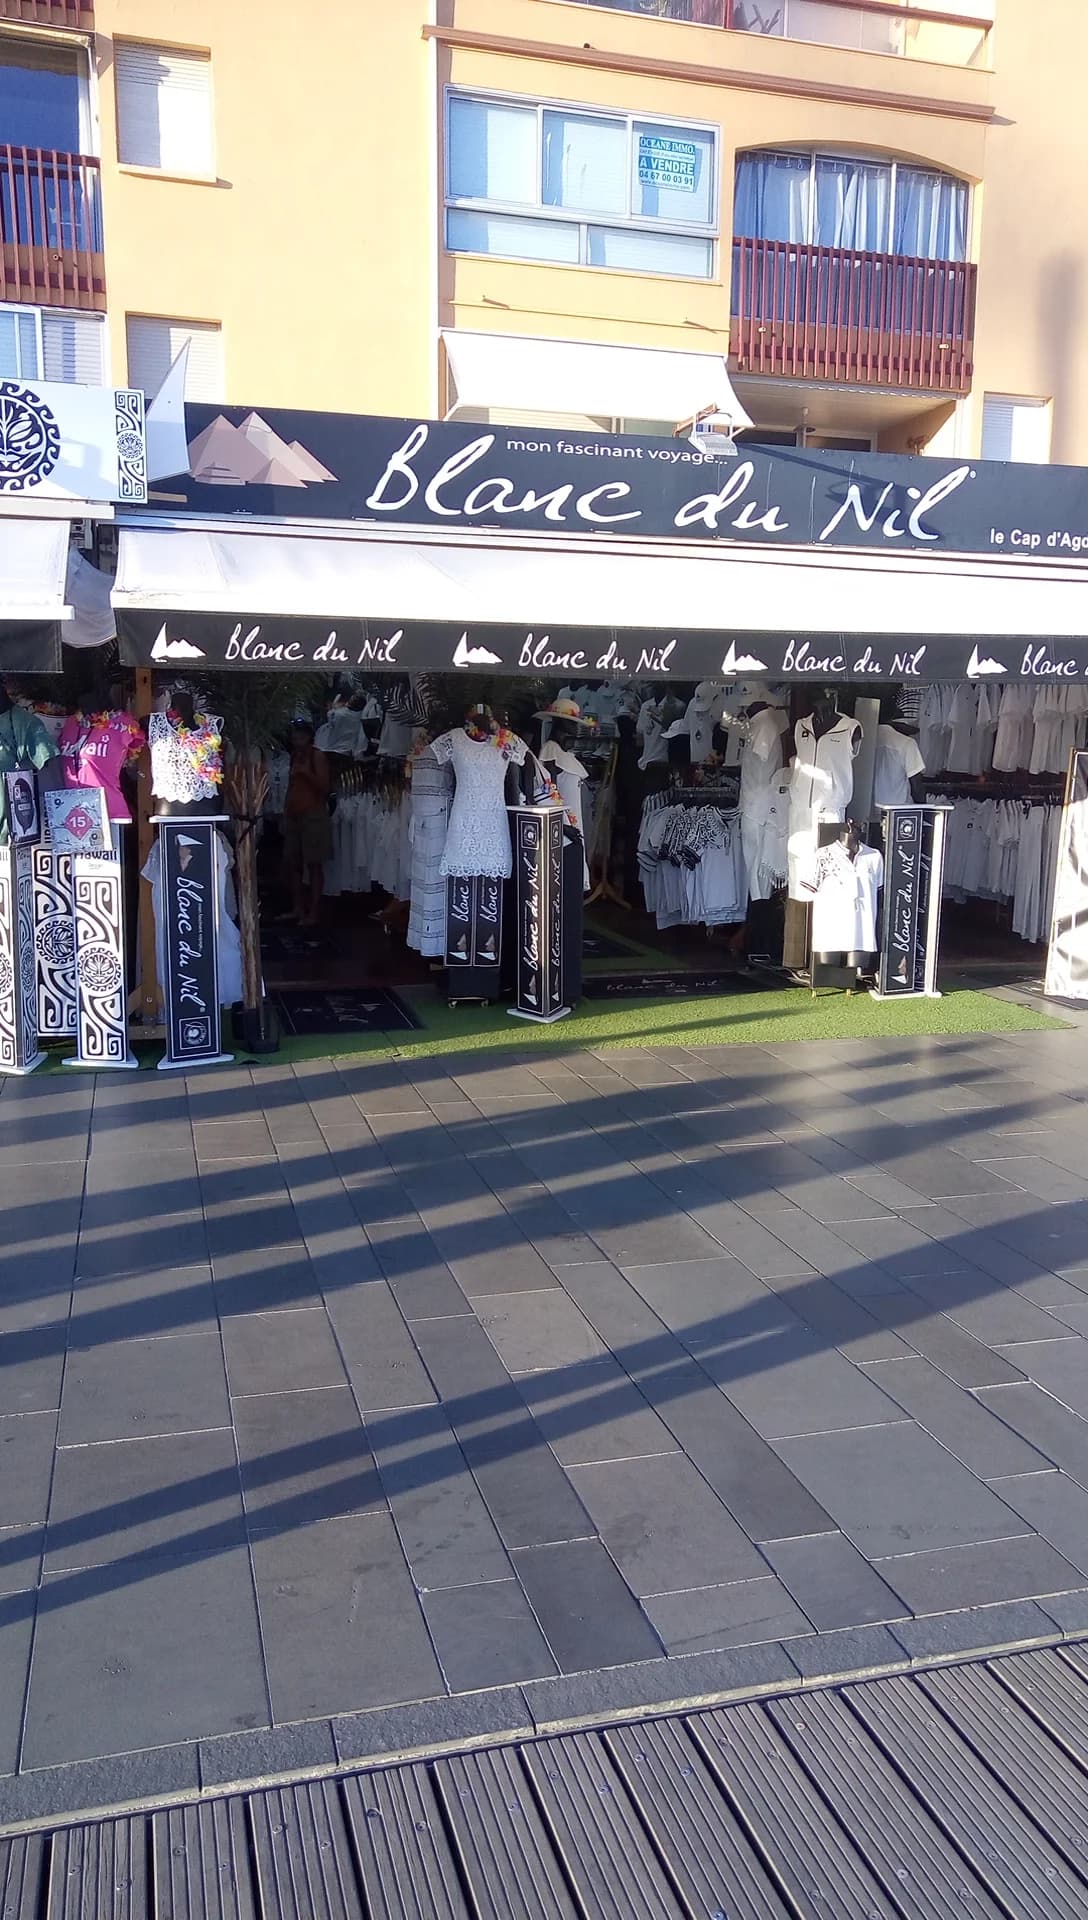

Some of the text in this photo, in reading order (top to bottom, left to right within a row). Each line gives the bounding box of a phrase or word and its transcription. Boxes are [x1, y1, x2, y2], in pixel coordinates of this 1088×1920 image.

[641, 137, 671, 150] OCEANE
[640, 157, 694, 174] A VENDRE
[640, 170, 648, 178] 04
[650, 172, 660, 180] 67
[662, 174, 671, 182] 00
[673, 175, 682, 183] 03
[684, 177, 693, 185] 91
[507, 440, 550, 452] mon
[556, 440, 643, 459] fascinant
[365, 424, 642, 523] Blanc
[674, 462, 789, 532] du
[990, 528, 1005, 544] le
[1010, 529, 1041, 549] Cap
[312, 631, 349, 662] du
[357, 629, 403, 664] Nil
[596, 640, 628, 670] du
[636, 639, 677, 673] Nil
[853, 646, 882, 675] du
[889, 645, 926, 676] Nil
[70, 816, 86, 828] 15
[522, 856, 540, 890] Nil
[898, 850, 914, 878] Nil
[524, 893, 540, 918] du
[897, 882, 913, 903] du
[178, 940, 202, 967] du
[178, 973, 206, 1008] Nil
